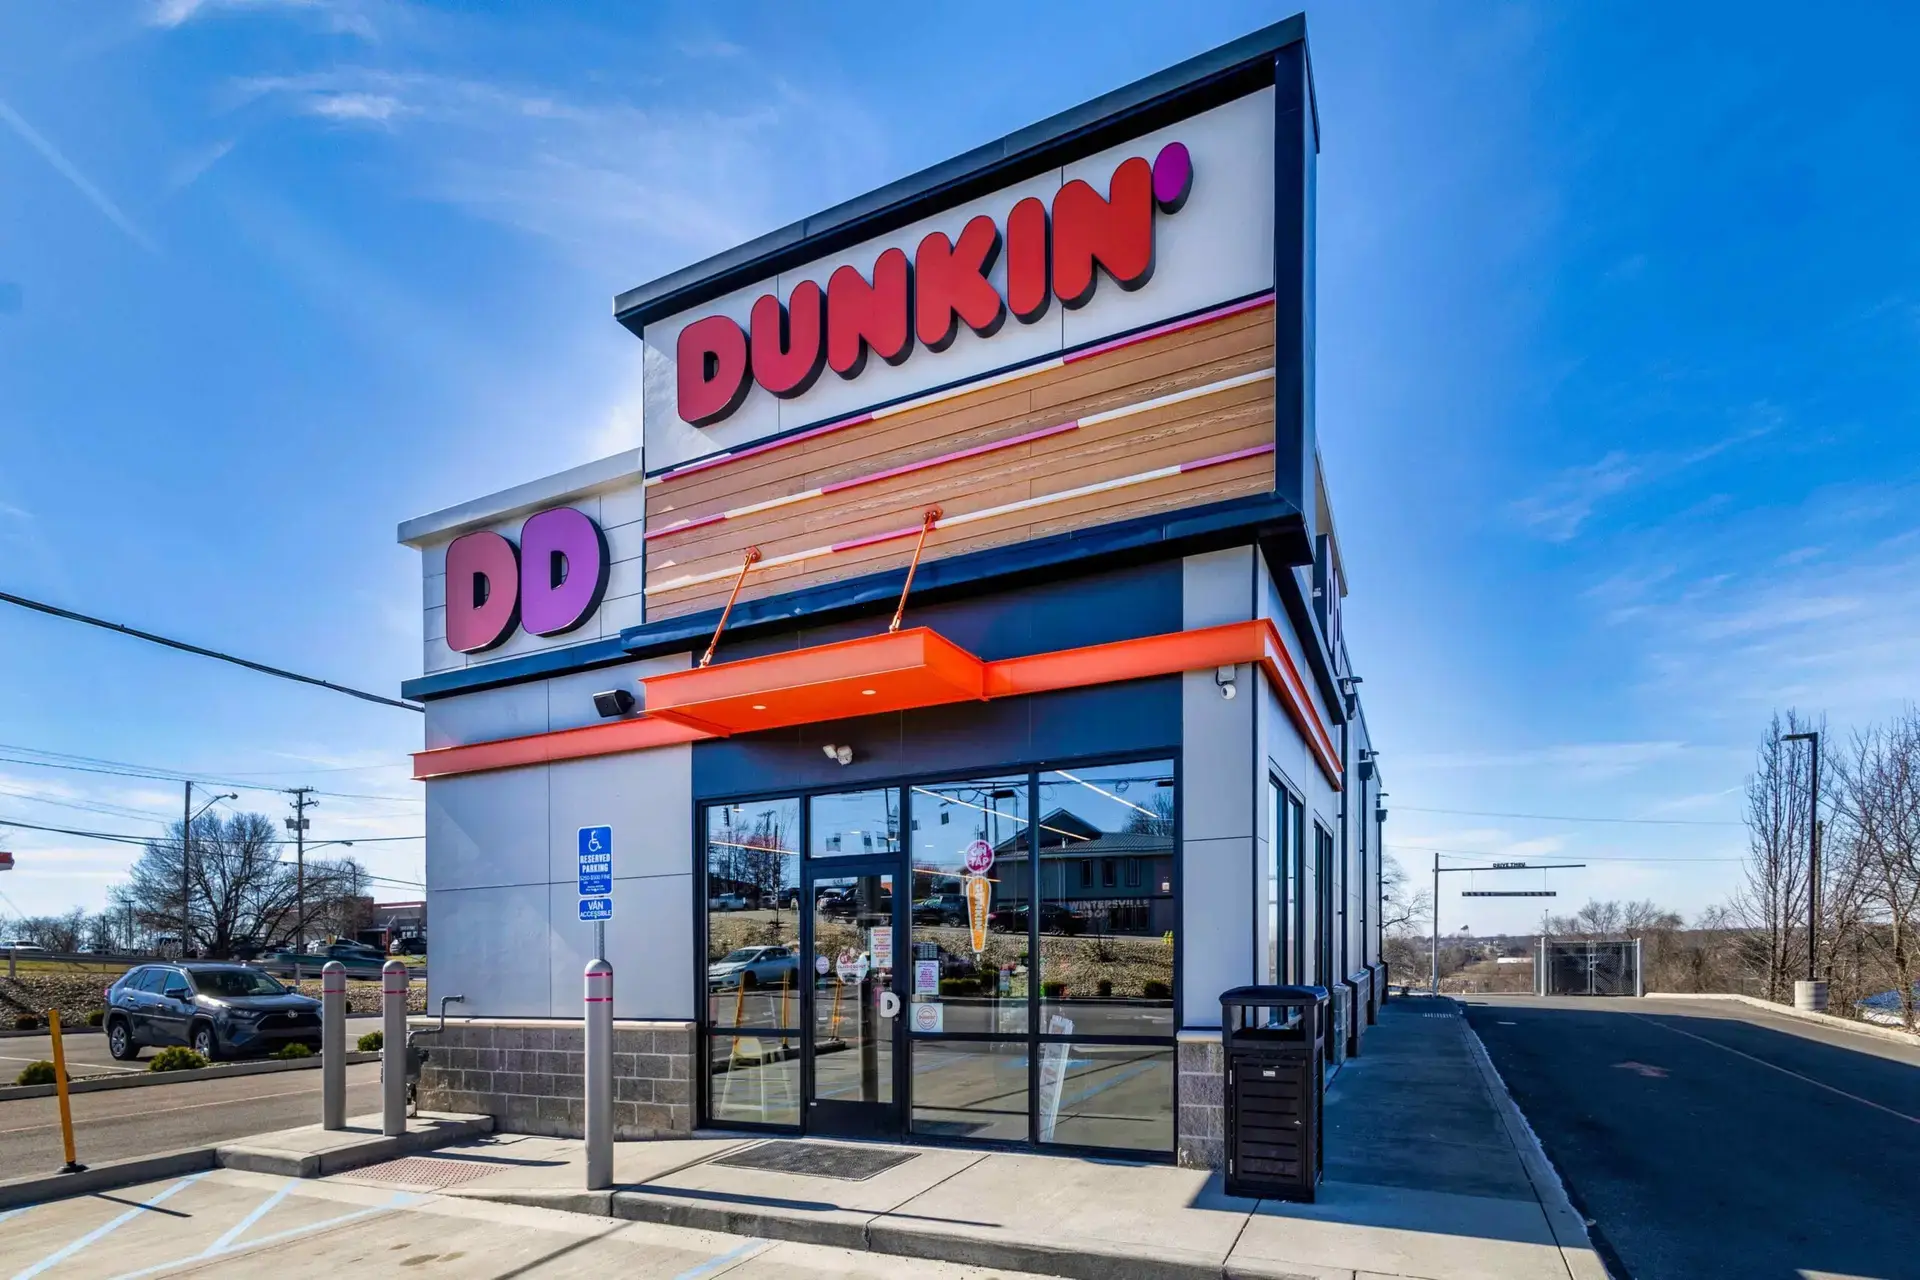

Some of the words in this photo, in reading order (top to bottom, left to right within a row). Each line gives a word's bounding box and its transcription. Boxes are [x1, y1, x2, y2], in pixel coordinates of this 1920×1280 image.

[677, 141, 1193, 427] DUNKIN'
[446, 507, 610, 654] DD
[580, 854, 610, 864] RESERVED
[970, 857, 989, 867] TAP
[582, 863, 609, 873] PARKING
[588, 900, 604, 910] VAN
[1068, 899, 1150, 910] WINTERSVILLE
[580, 910, 612, 918] ACCESSIBLE
